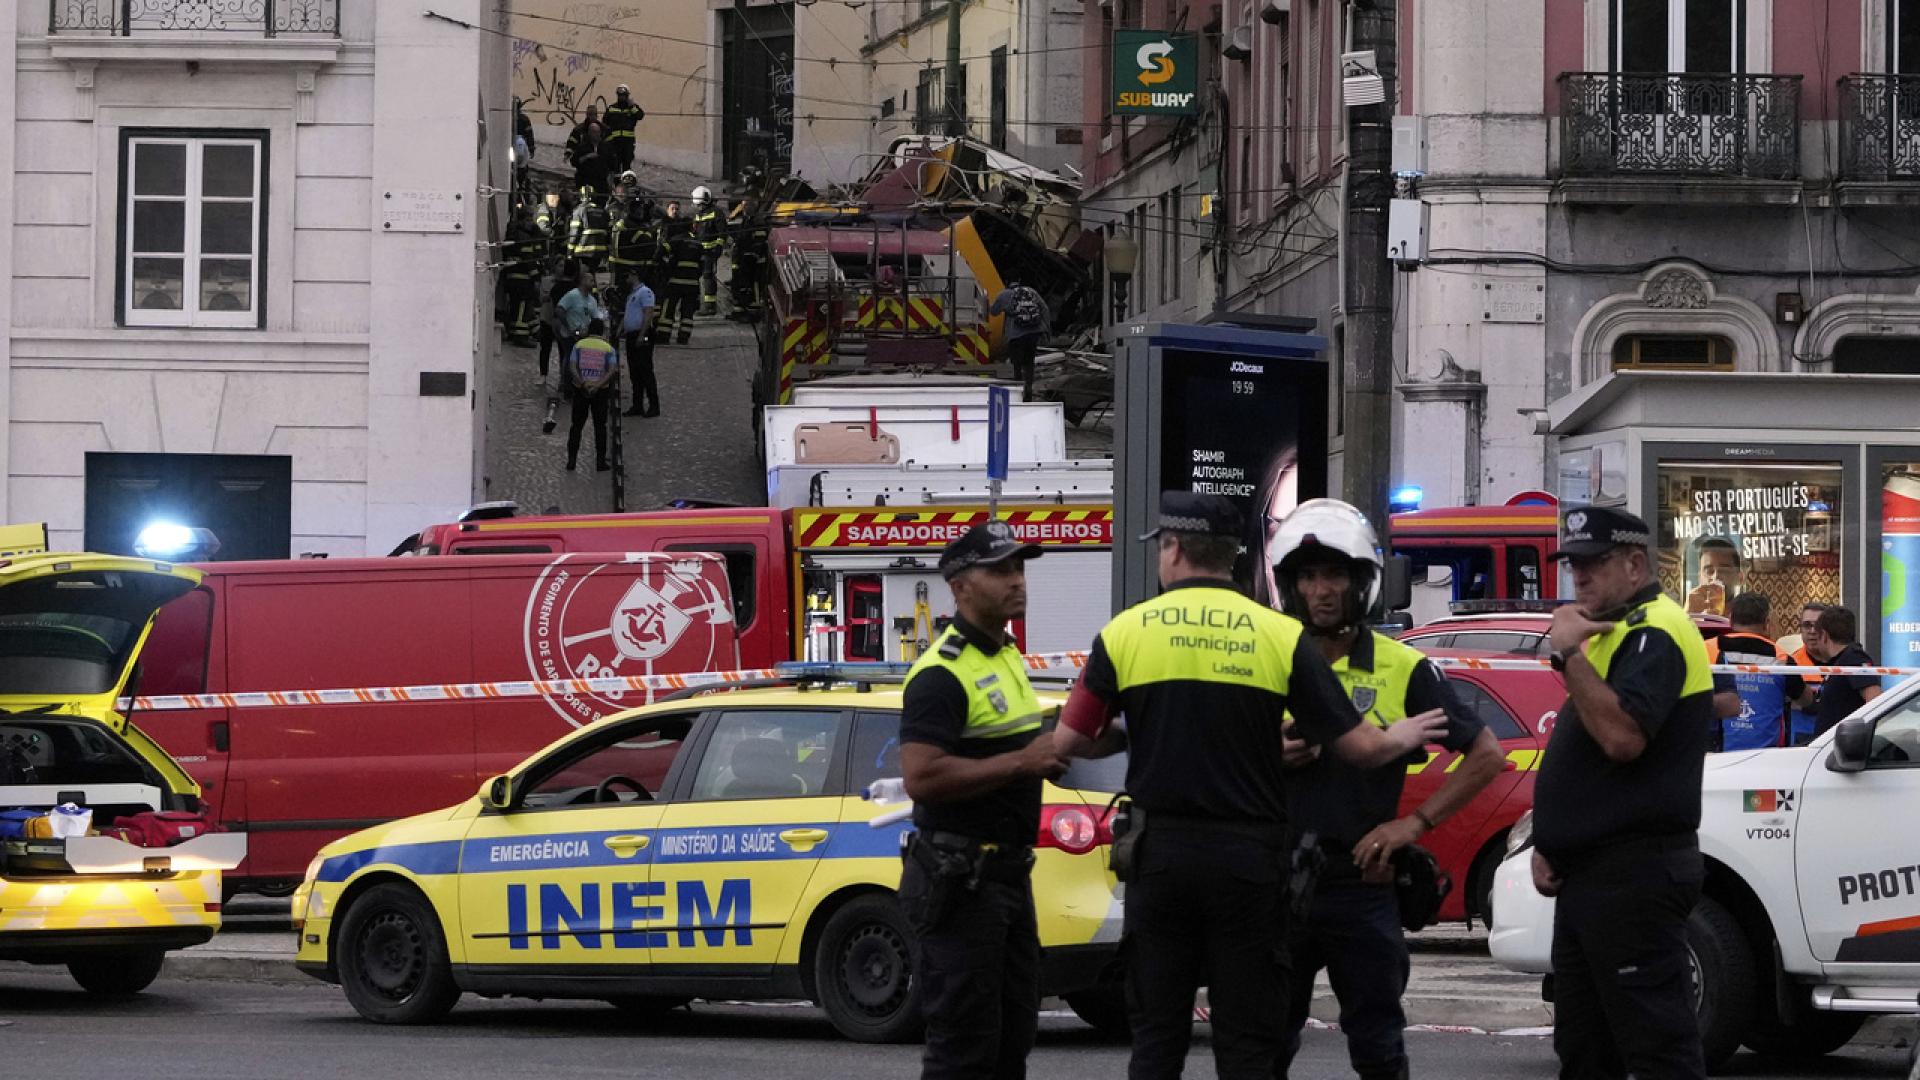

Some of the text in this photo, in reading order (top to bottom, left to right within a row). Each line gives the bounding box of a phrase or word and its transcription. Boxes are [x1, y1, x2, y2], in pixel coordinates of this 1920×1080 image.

[1116, 92, 1195, 108] SUBWAY
[1193, 449, 1225, 463] SHAMIR
[1724, 447, 1776, 456] DREAMMEDIA
[1192, 465, 1245, 481] AUTOGRAPH
[1694, 480, 1810, 513] SER PORTUGUÊS
[847, 524, 970, 541] SAPADORES
[1010, 523, 1102, 539] MBEIROS
[1673, 511, 1790, 539] NÃO SE EXPLICA,
[1742, 533, 1810, 559] SENTE-SE
[538, 569, 569, 637] REGIMENTO
[1142, 605, 1255, 633] POLÍCIA
[538, 641, 551, 657] DE
[1169, 634, 1256, 656] municipal
[1212, 662, 1254, 678] Lisboa
[490, 839, 590, 863] EMERGÊNCIA
[660, 828, 777, 856] MINISTÉRIO DA SAÚDE
[1838, 864, 1920, 906] PROT
[506, 878, 754, 950] INEM
